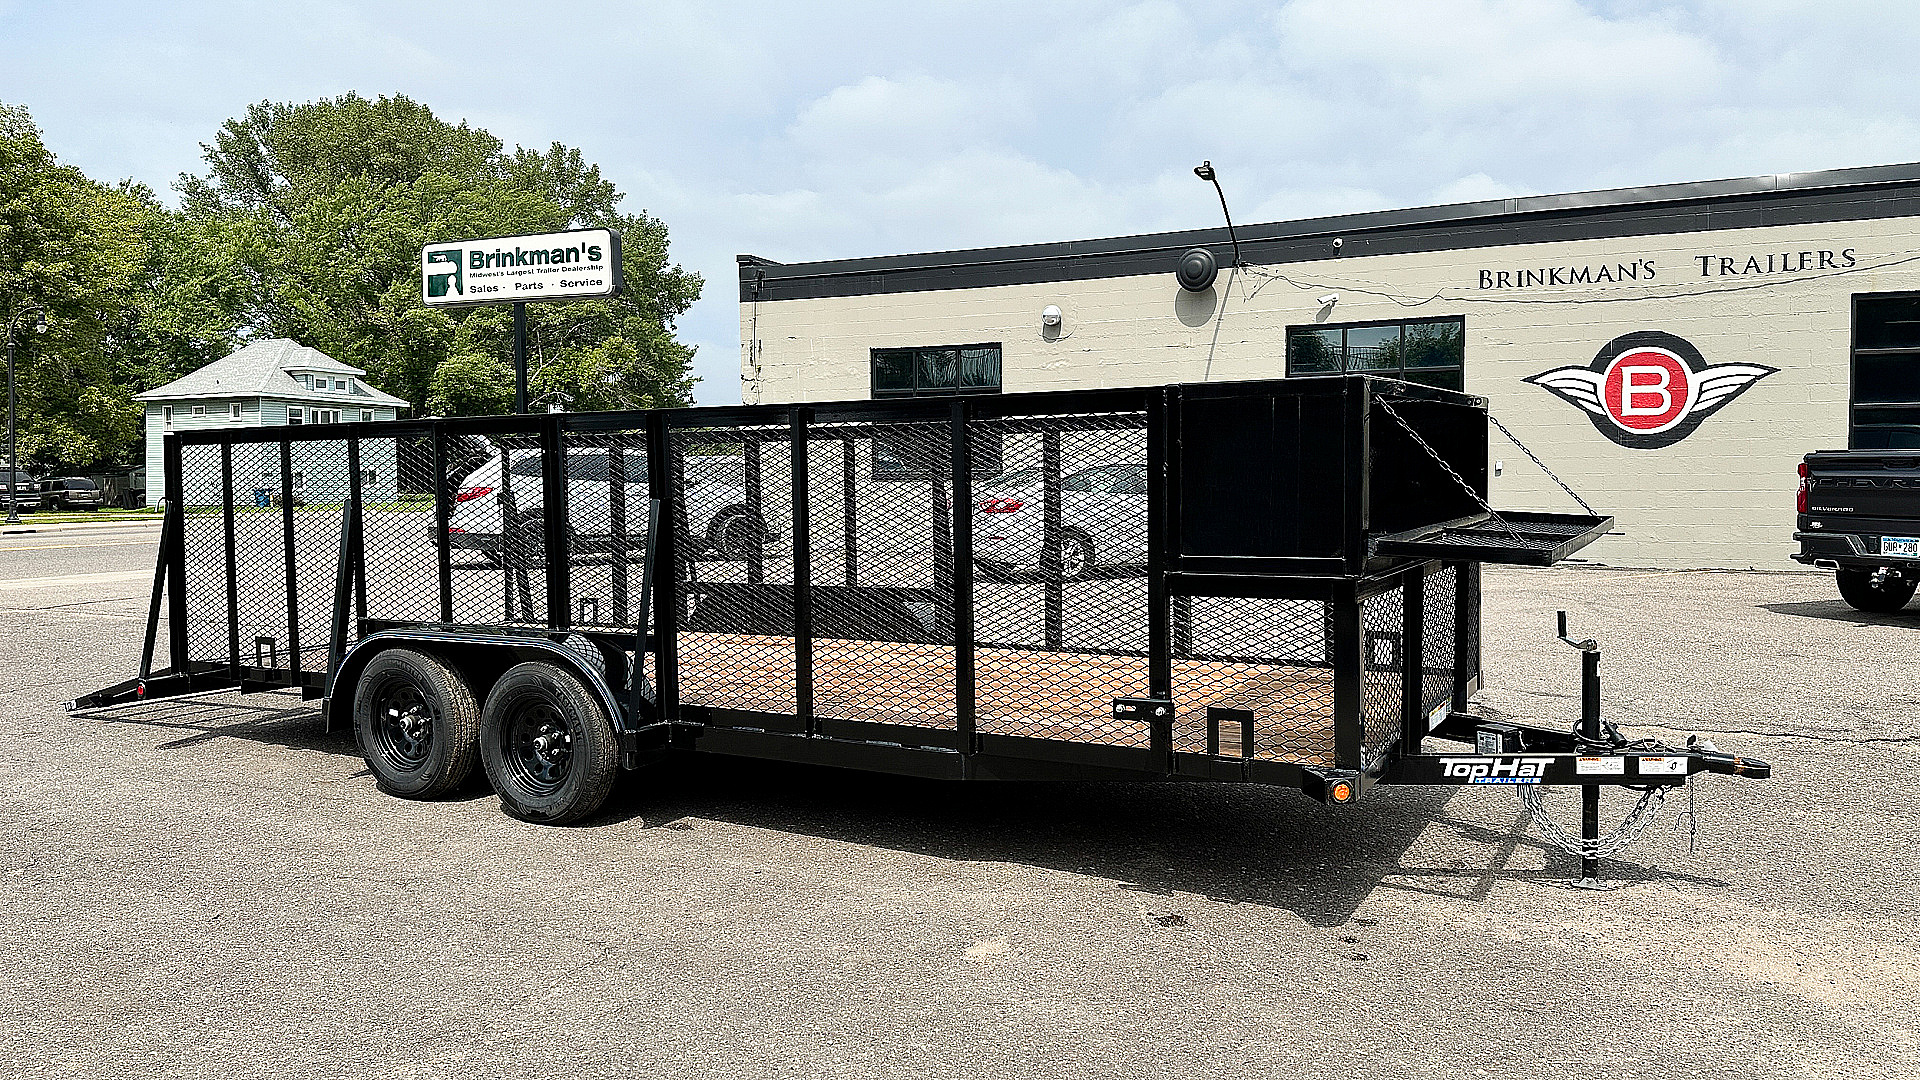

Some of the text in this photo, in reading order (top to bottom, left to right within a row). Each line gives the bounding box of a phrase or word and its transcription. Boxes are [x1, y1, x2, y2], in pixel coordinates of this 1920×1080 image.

[469, 242, 602, 269] Brinkman's
[506, 268, 534, 277] Largest
[561, 265, 604, 273] Dealership
[1478, 248, 1856, 290] BRINKMAN'S TRAILERS
[469, 279, 603, 294] Sales Parts Service
[1620, 365, 1672, 417] B
[1818, 478, 1920, 489] CHEVR
